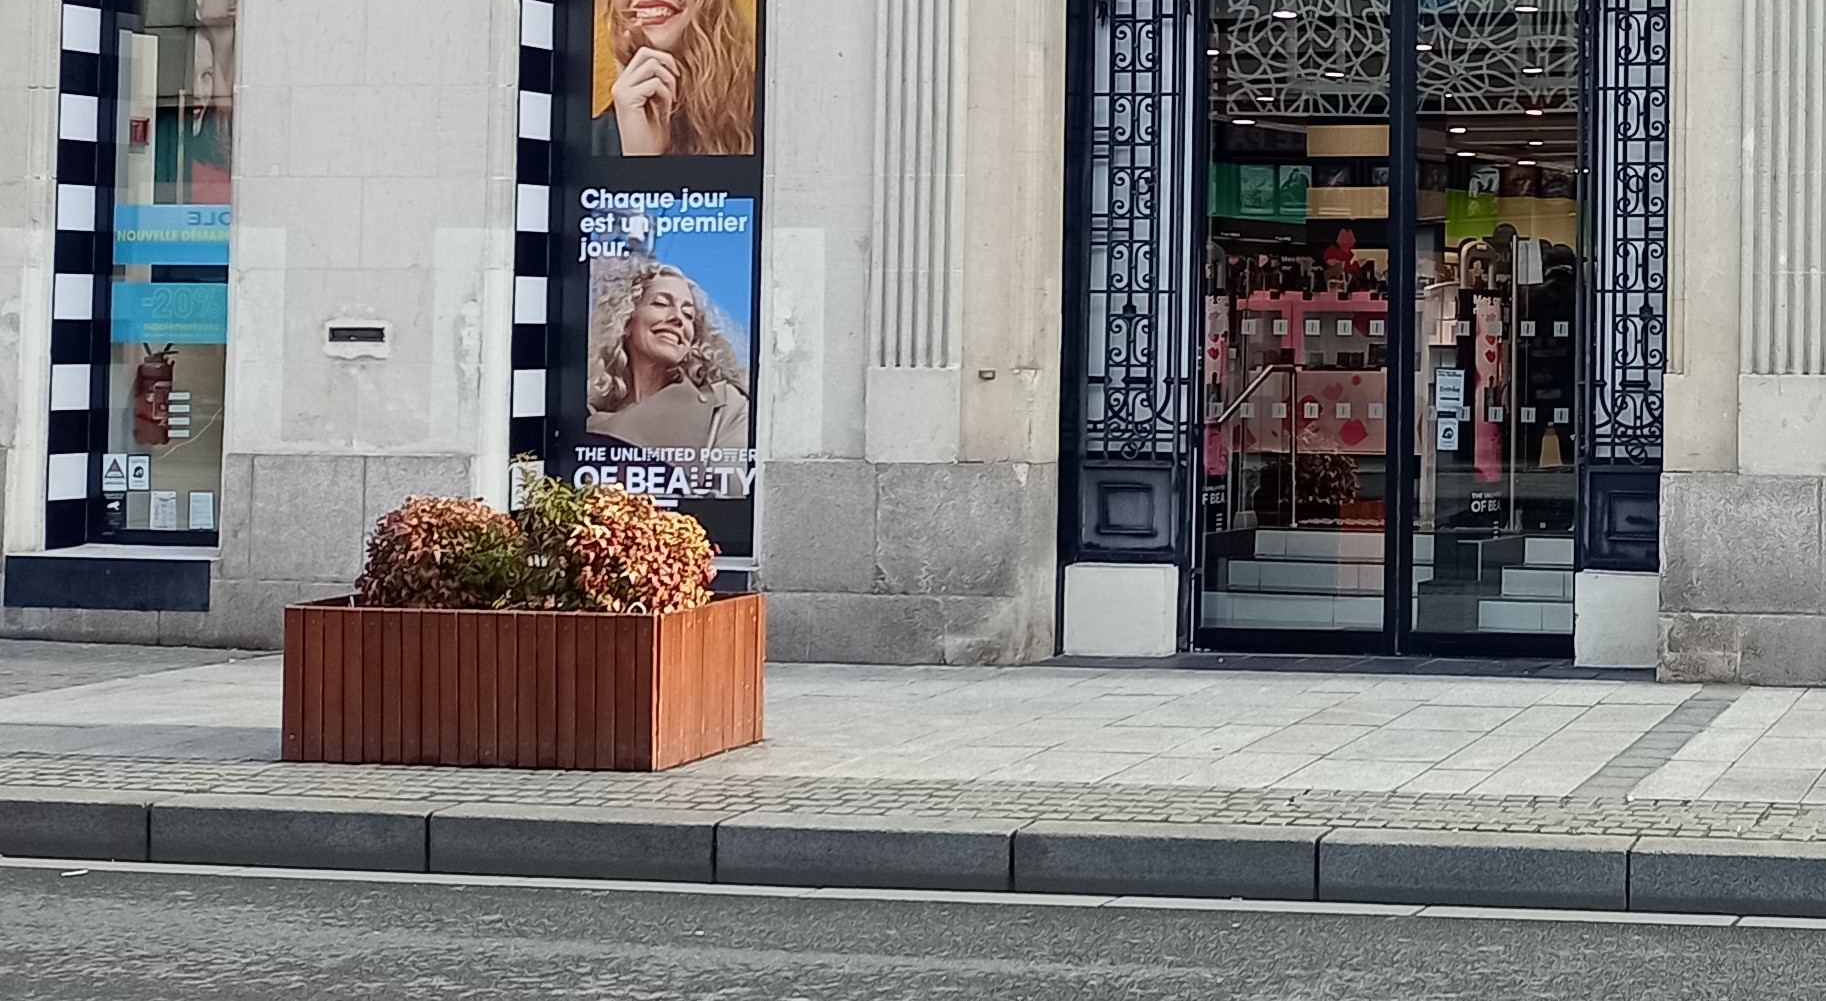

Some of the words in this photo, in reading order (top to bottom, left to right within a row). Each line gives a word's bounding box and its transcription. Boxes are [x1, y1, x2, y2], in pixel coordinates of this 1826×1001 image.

[581, 188, 674, 212] Chaque
[680, 188, 727, 212] jour
[117, 230, 178, 241] NOUVELLE
[580, 214, 614, 232] est
[621, 216, 649, 232] un
[657, 212, 747, 236] premier
[579, 237, 629, 262] jour.
[142, 287, 222, 319] -20%
[574, 447, 606, 461] THE
[610, 447, 695, 462] UNLIMITED
[700, 448, 757, 462] POWER
[573, 466, 618, 488] OF
[626, 466, 757, 495] BEAUTY
